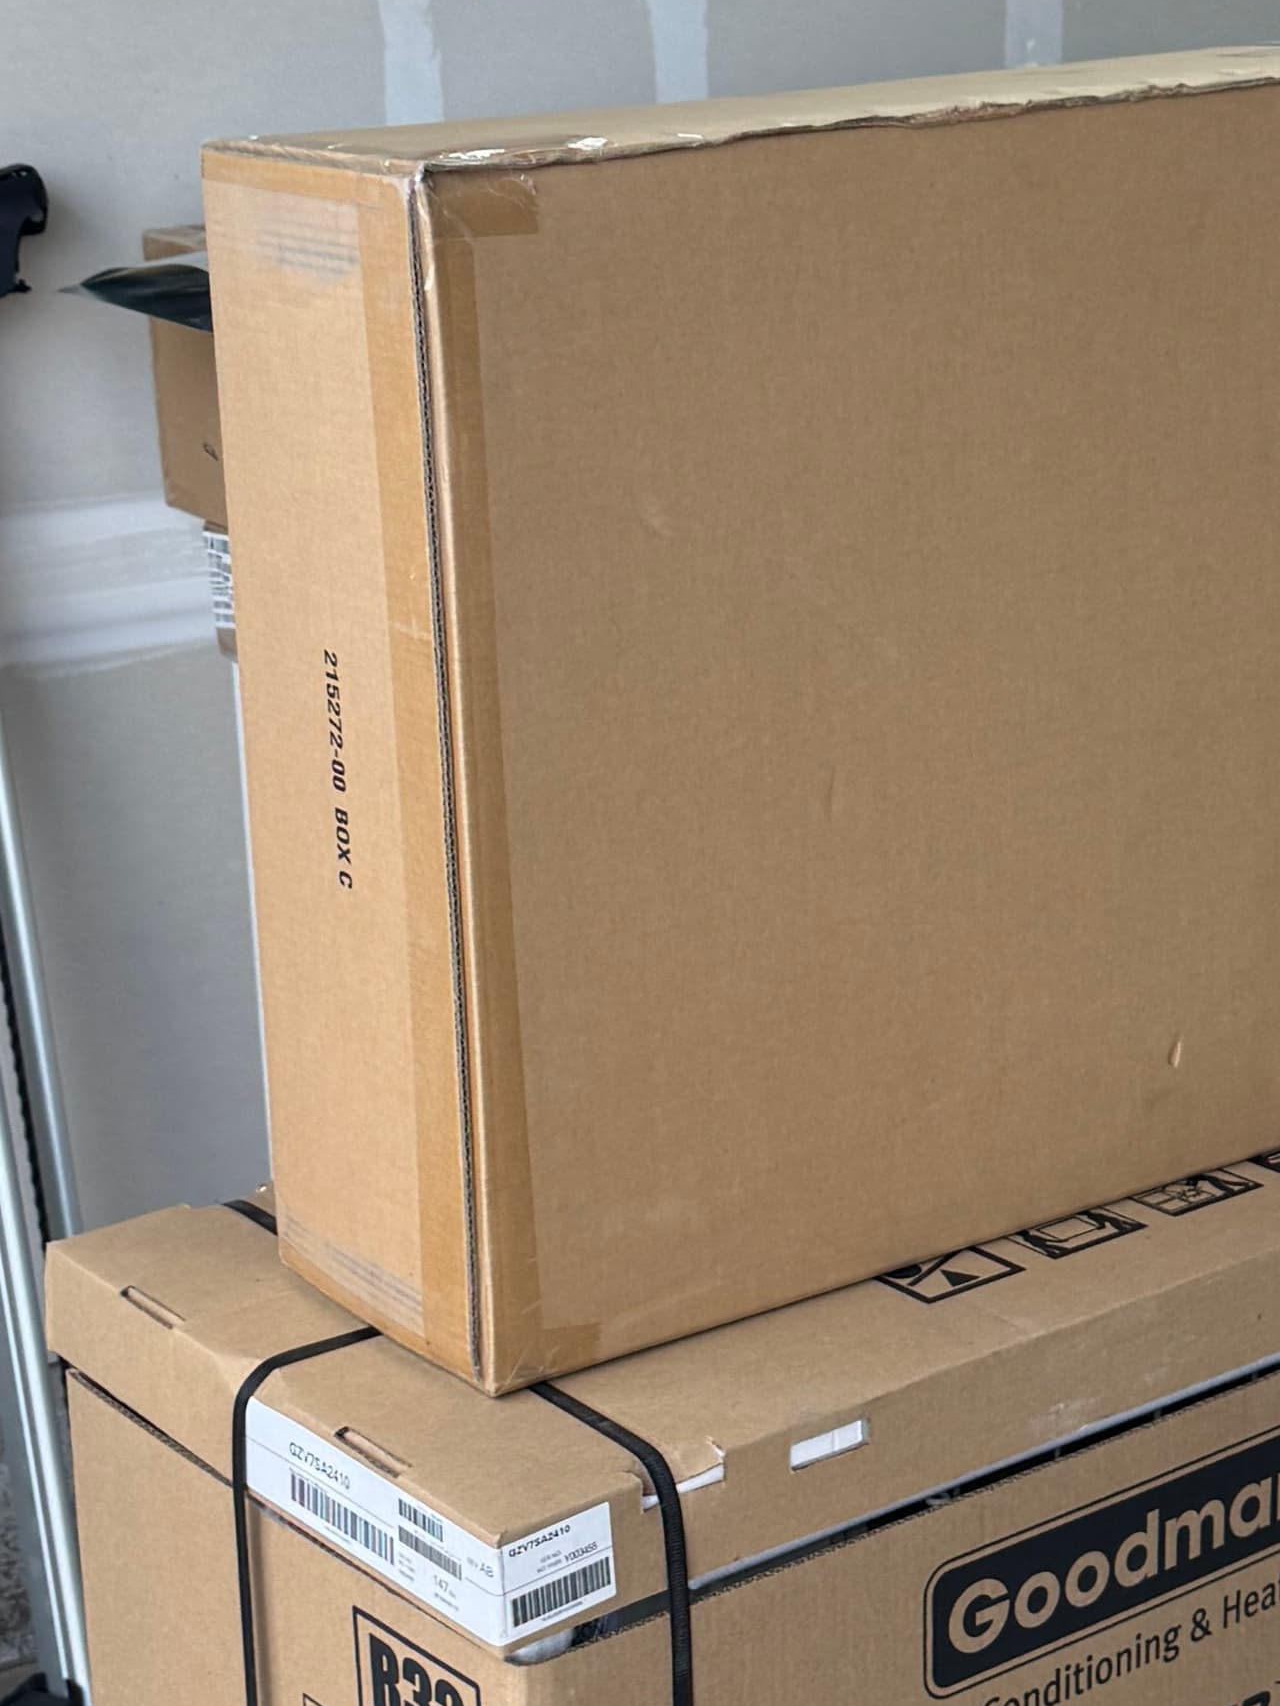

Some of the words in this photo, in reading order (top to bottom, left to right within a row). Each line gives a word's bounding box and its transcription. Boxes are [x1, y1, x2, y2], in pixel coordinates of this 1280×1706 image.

[323, 649, 346, 793] 215272-00
[334, 806, 352, 865] BOX
[338, 870, 353, 890] C
[1190, 1608, 1212, 1643] &
